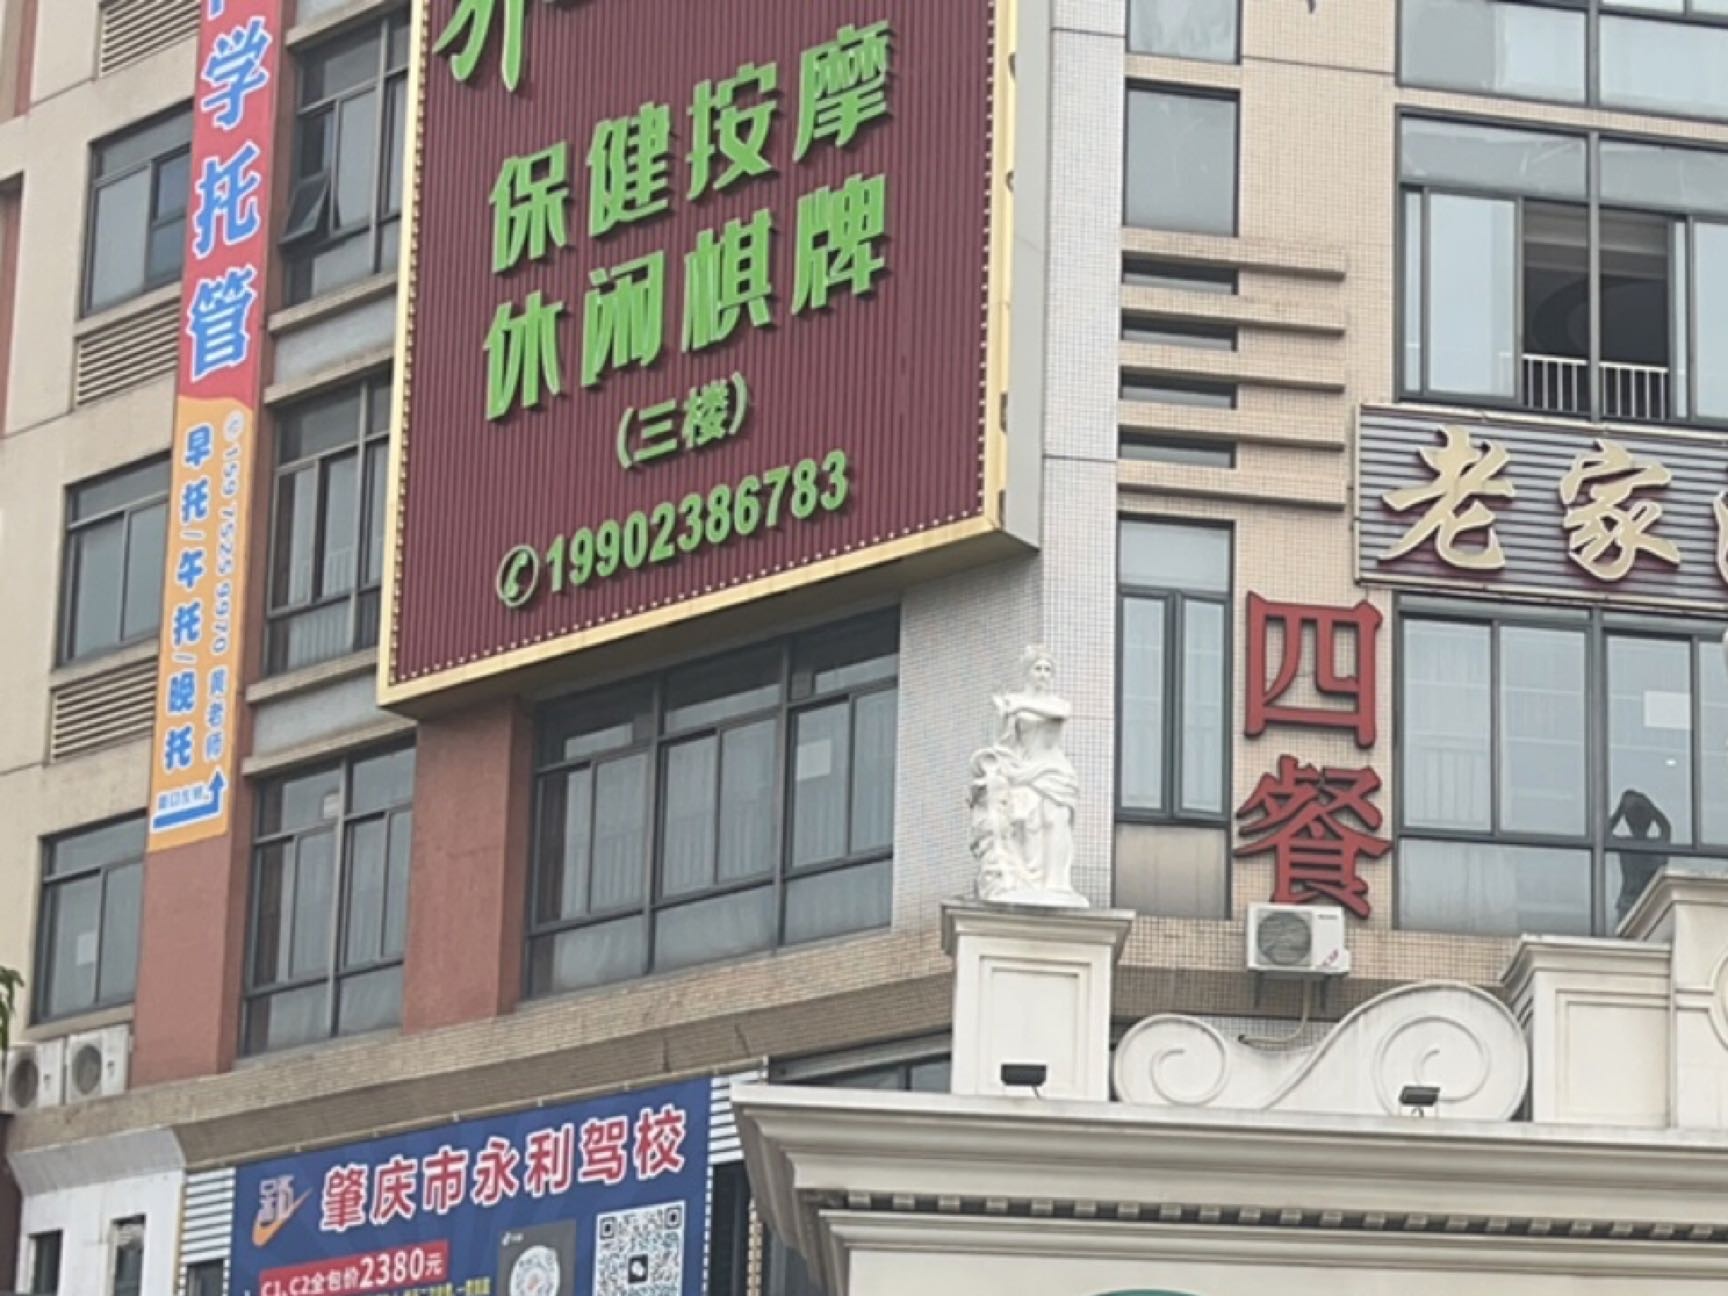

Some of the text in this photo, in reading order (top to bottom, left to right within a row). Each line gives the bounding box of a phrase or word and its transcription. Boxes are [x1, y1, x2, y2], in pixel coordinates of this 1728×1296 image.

[188, 0, 273, 382] 学托管
[488, 21, 892, 275] 保健按摩
[483, 173, 887, 422] 休闲棋牌
[616, 372, 748, 469] (三楼)
[547, 450, 849, 593] 19902386783
[319, 1103, 687, 1232] 肇庆市永利驾校
